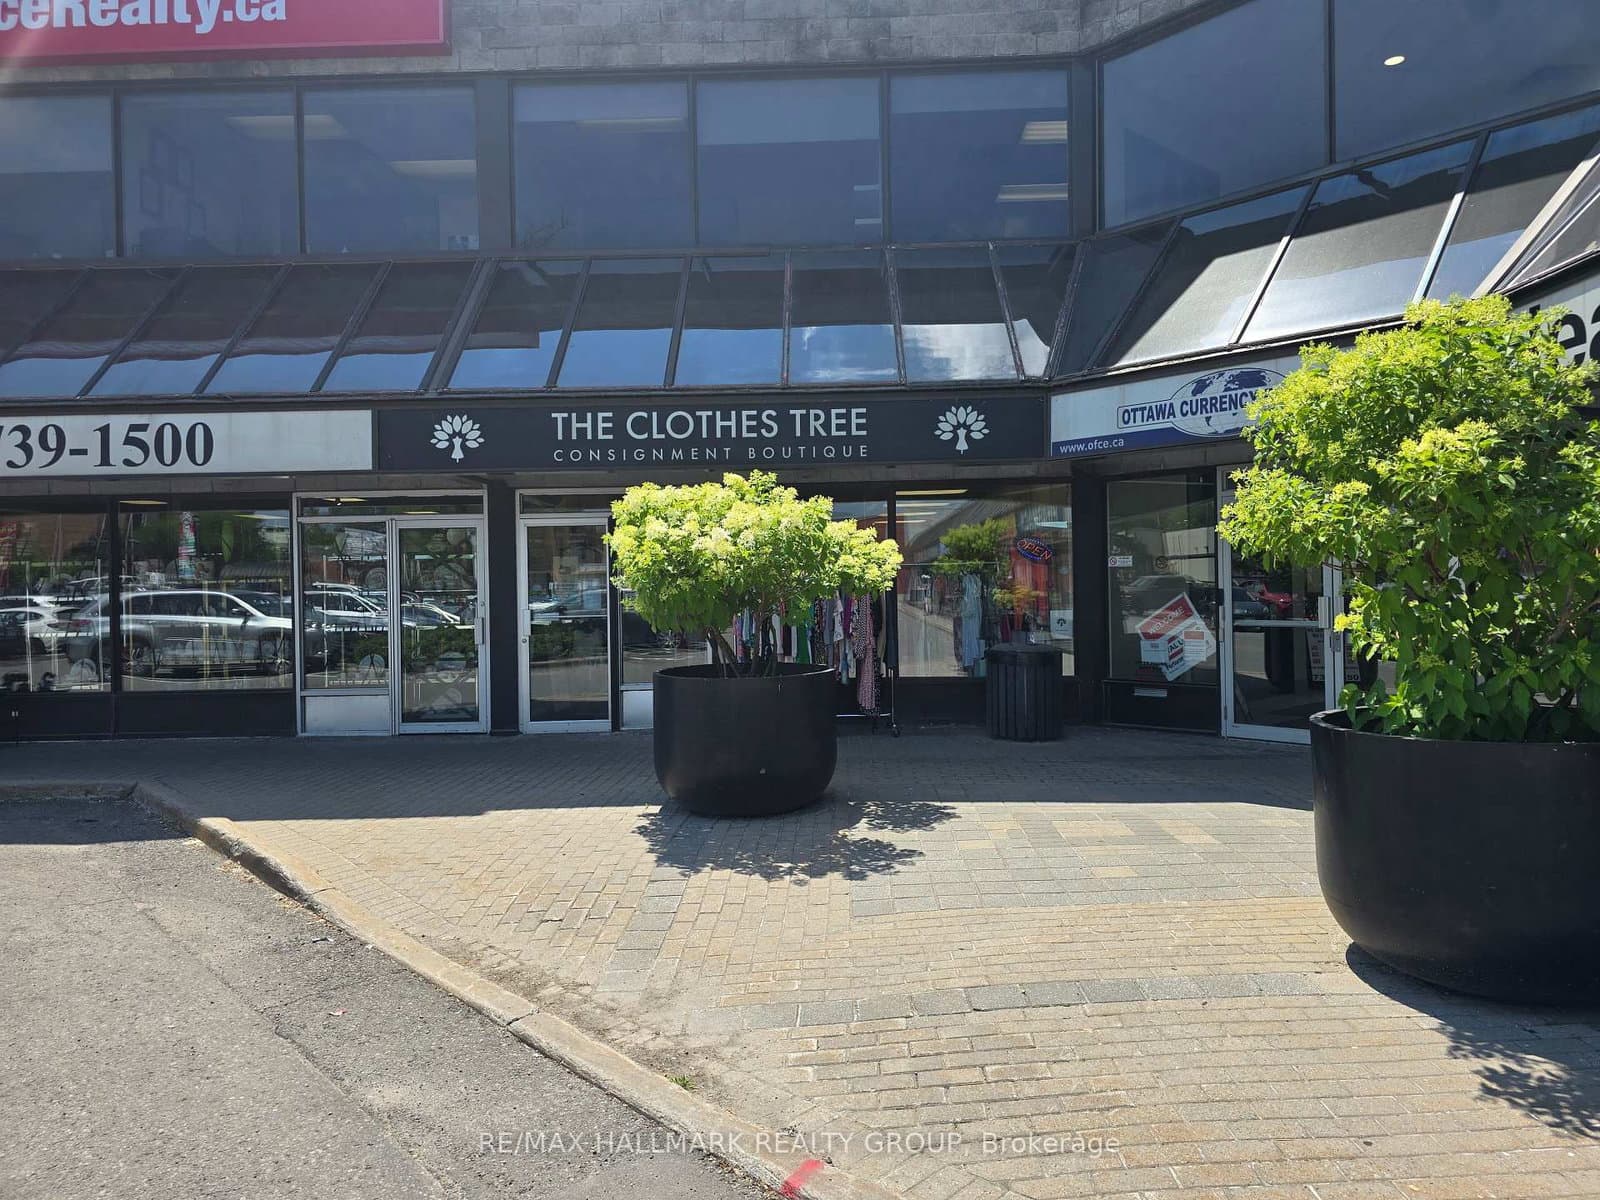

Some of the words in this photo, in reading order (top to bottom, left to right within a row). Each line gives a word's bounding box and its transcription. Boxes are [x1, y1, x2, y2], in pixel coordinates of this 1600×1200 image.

[552, 412, 614, 440] THE
[626, 409, 778, 439] CLOTHES
[789, 408, 867, 437] TREE
[1122, 402, 1176, 425] OTTAWA
[0, 422, 214, 468] 39-1500
[553, 447, 732, 462] CONSIGNMENT
[748, 445, 868, 460] BOUTIQUE
[1060, 438, 1124, 453] www.ofce.ca
